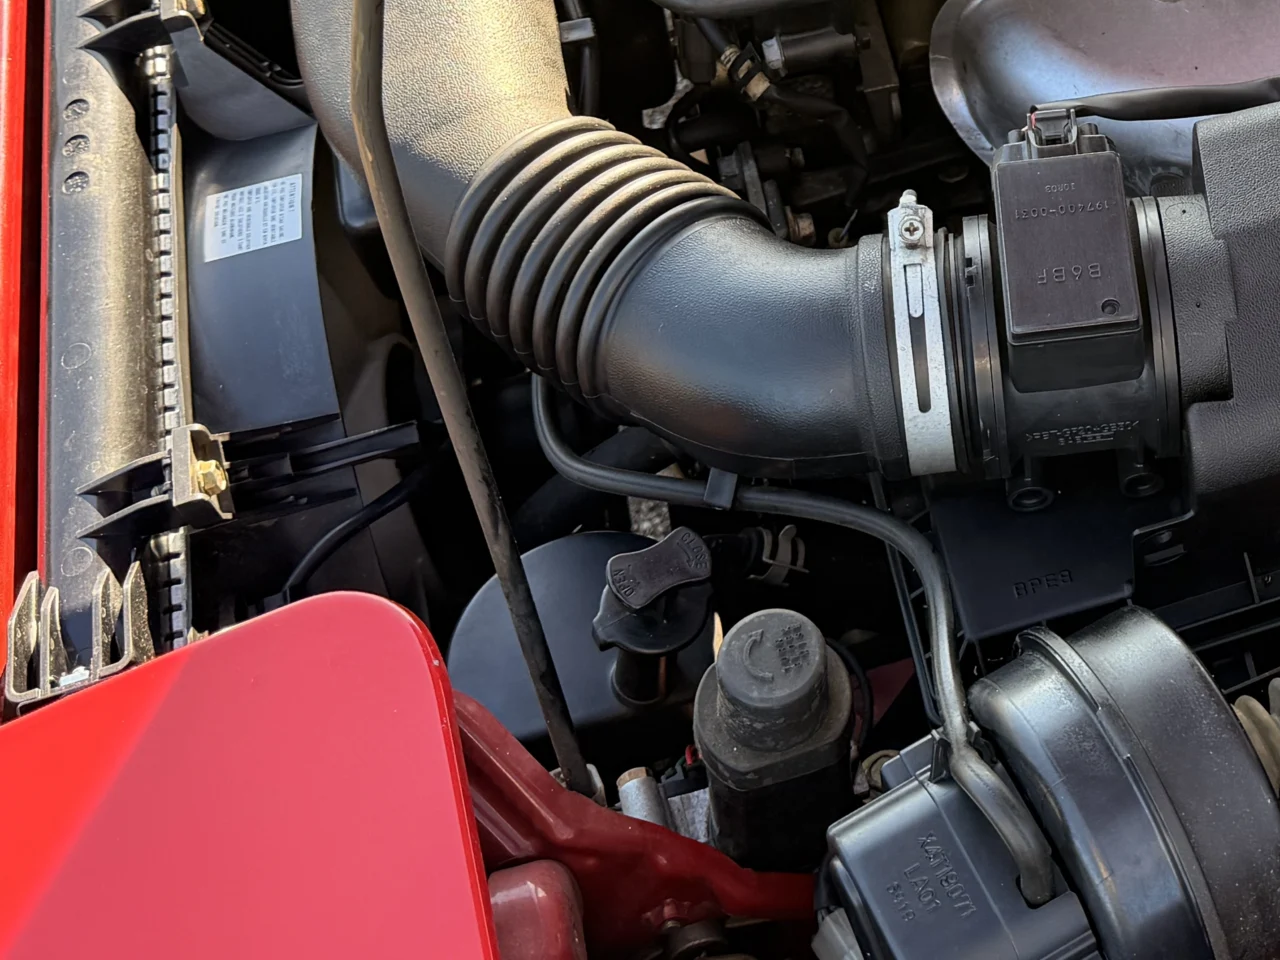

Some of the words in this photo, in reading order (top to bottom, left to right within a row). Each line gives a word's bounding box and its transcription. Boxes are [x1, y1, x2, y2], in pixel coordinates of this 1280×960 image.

[1014, 200, 1110, 220] 197400-0031
[1036, 262, 1101, 284] B6BF
[679, 531, 707, 569] CLOSE
[610, 562, 637, 600] OPEN
